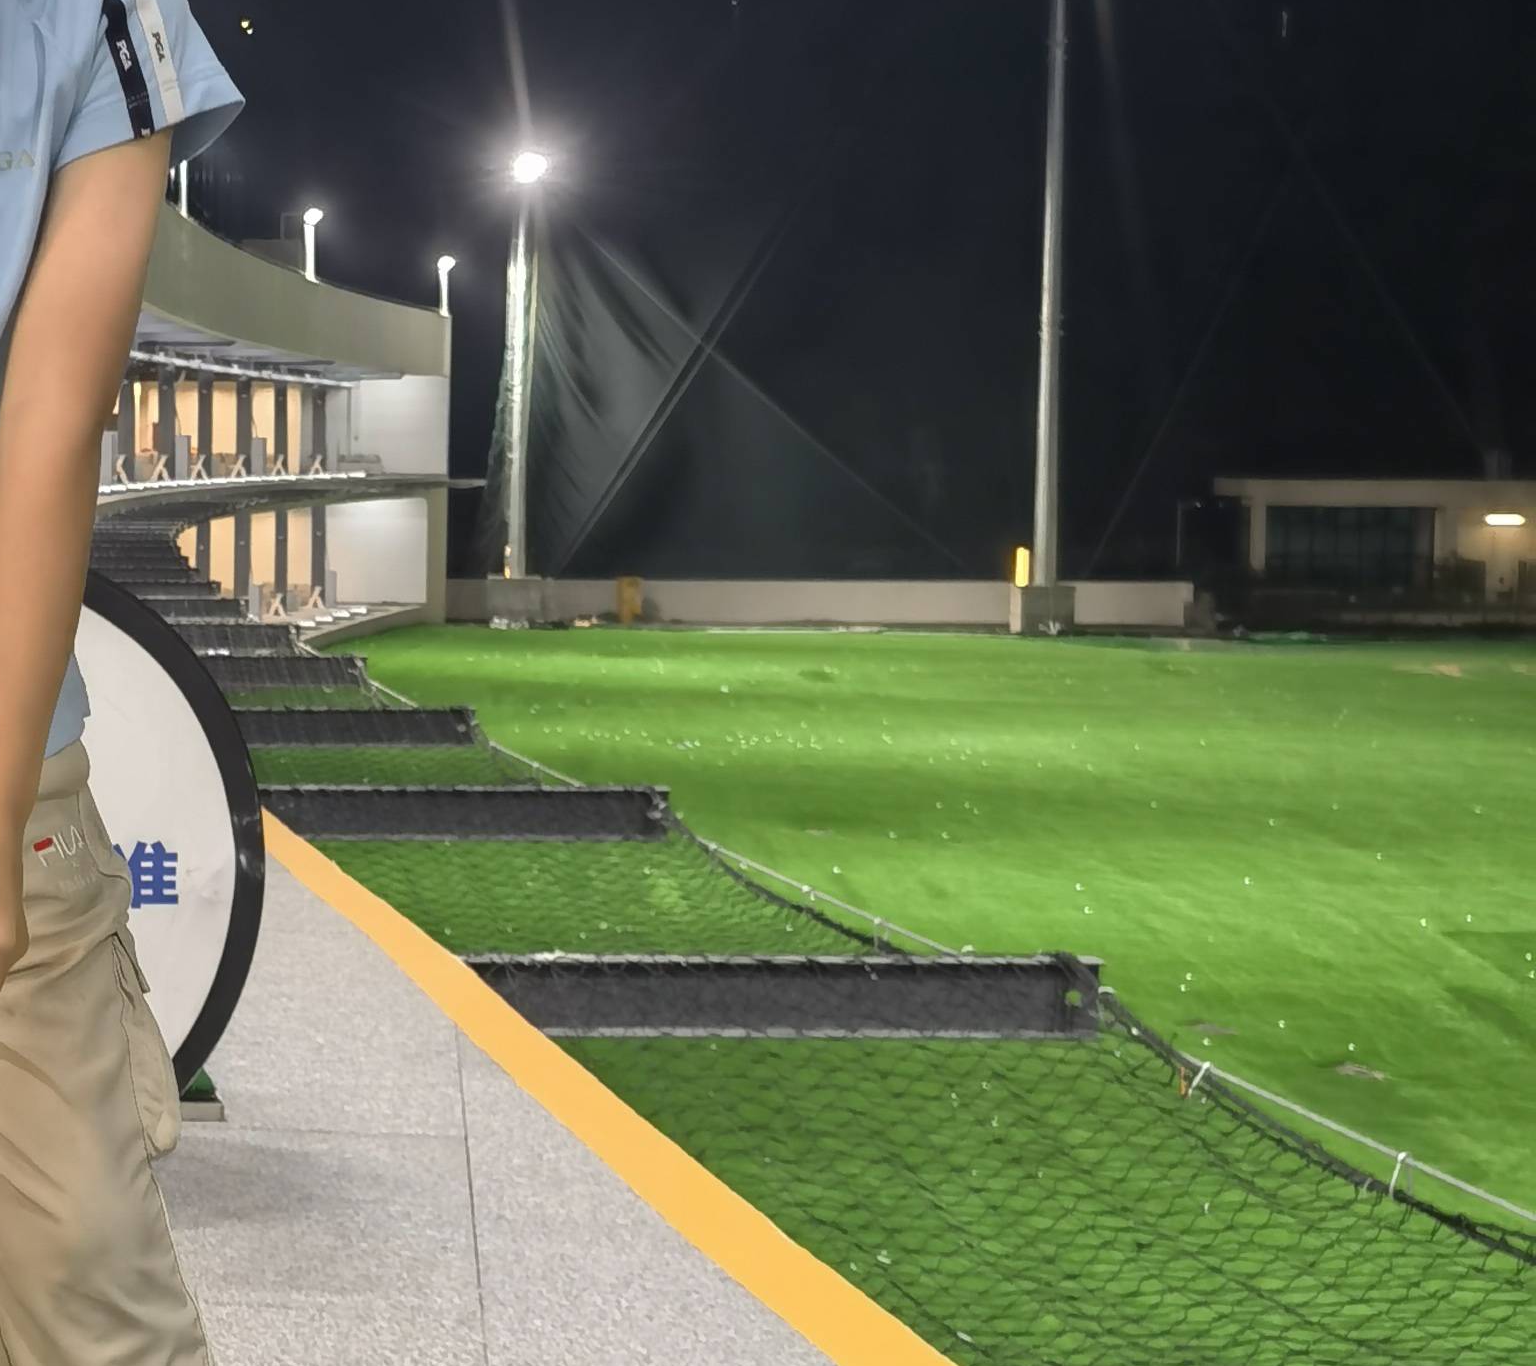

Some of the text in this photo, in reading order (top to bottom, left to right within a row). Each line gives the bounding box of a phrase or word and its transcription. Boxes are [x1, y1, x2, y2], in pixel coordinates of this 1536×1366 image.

[116, 39, 133, 73] PGA
[152, 31, 166, 64] PGA
[33, 825, 85, 868] FILA
